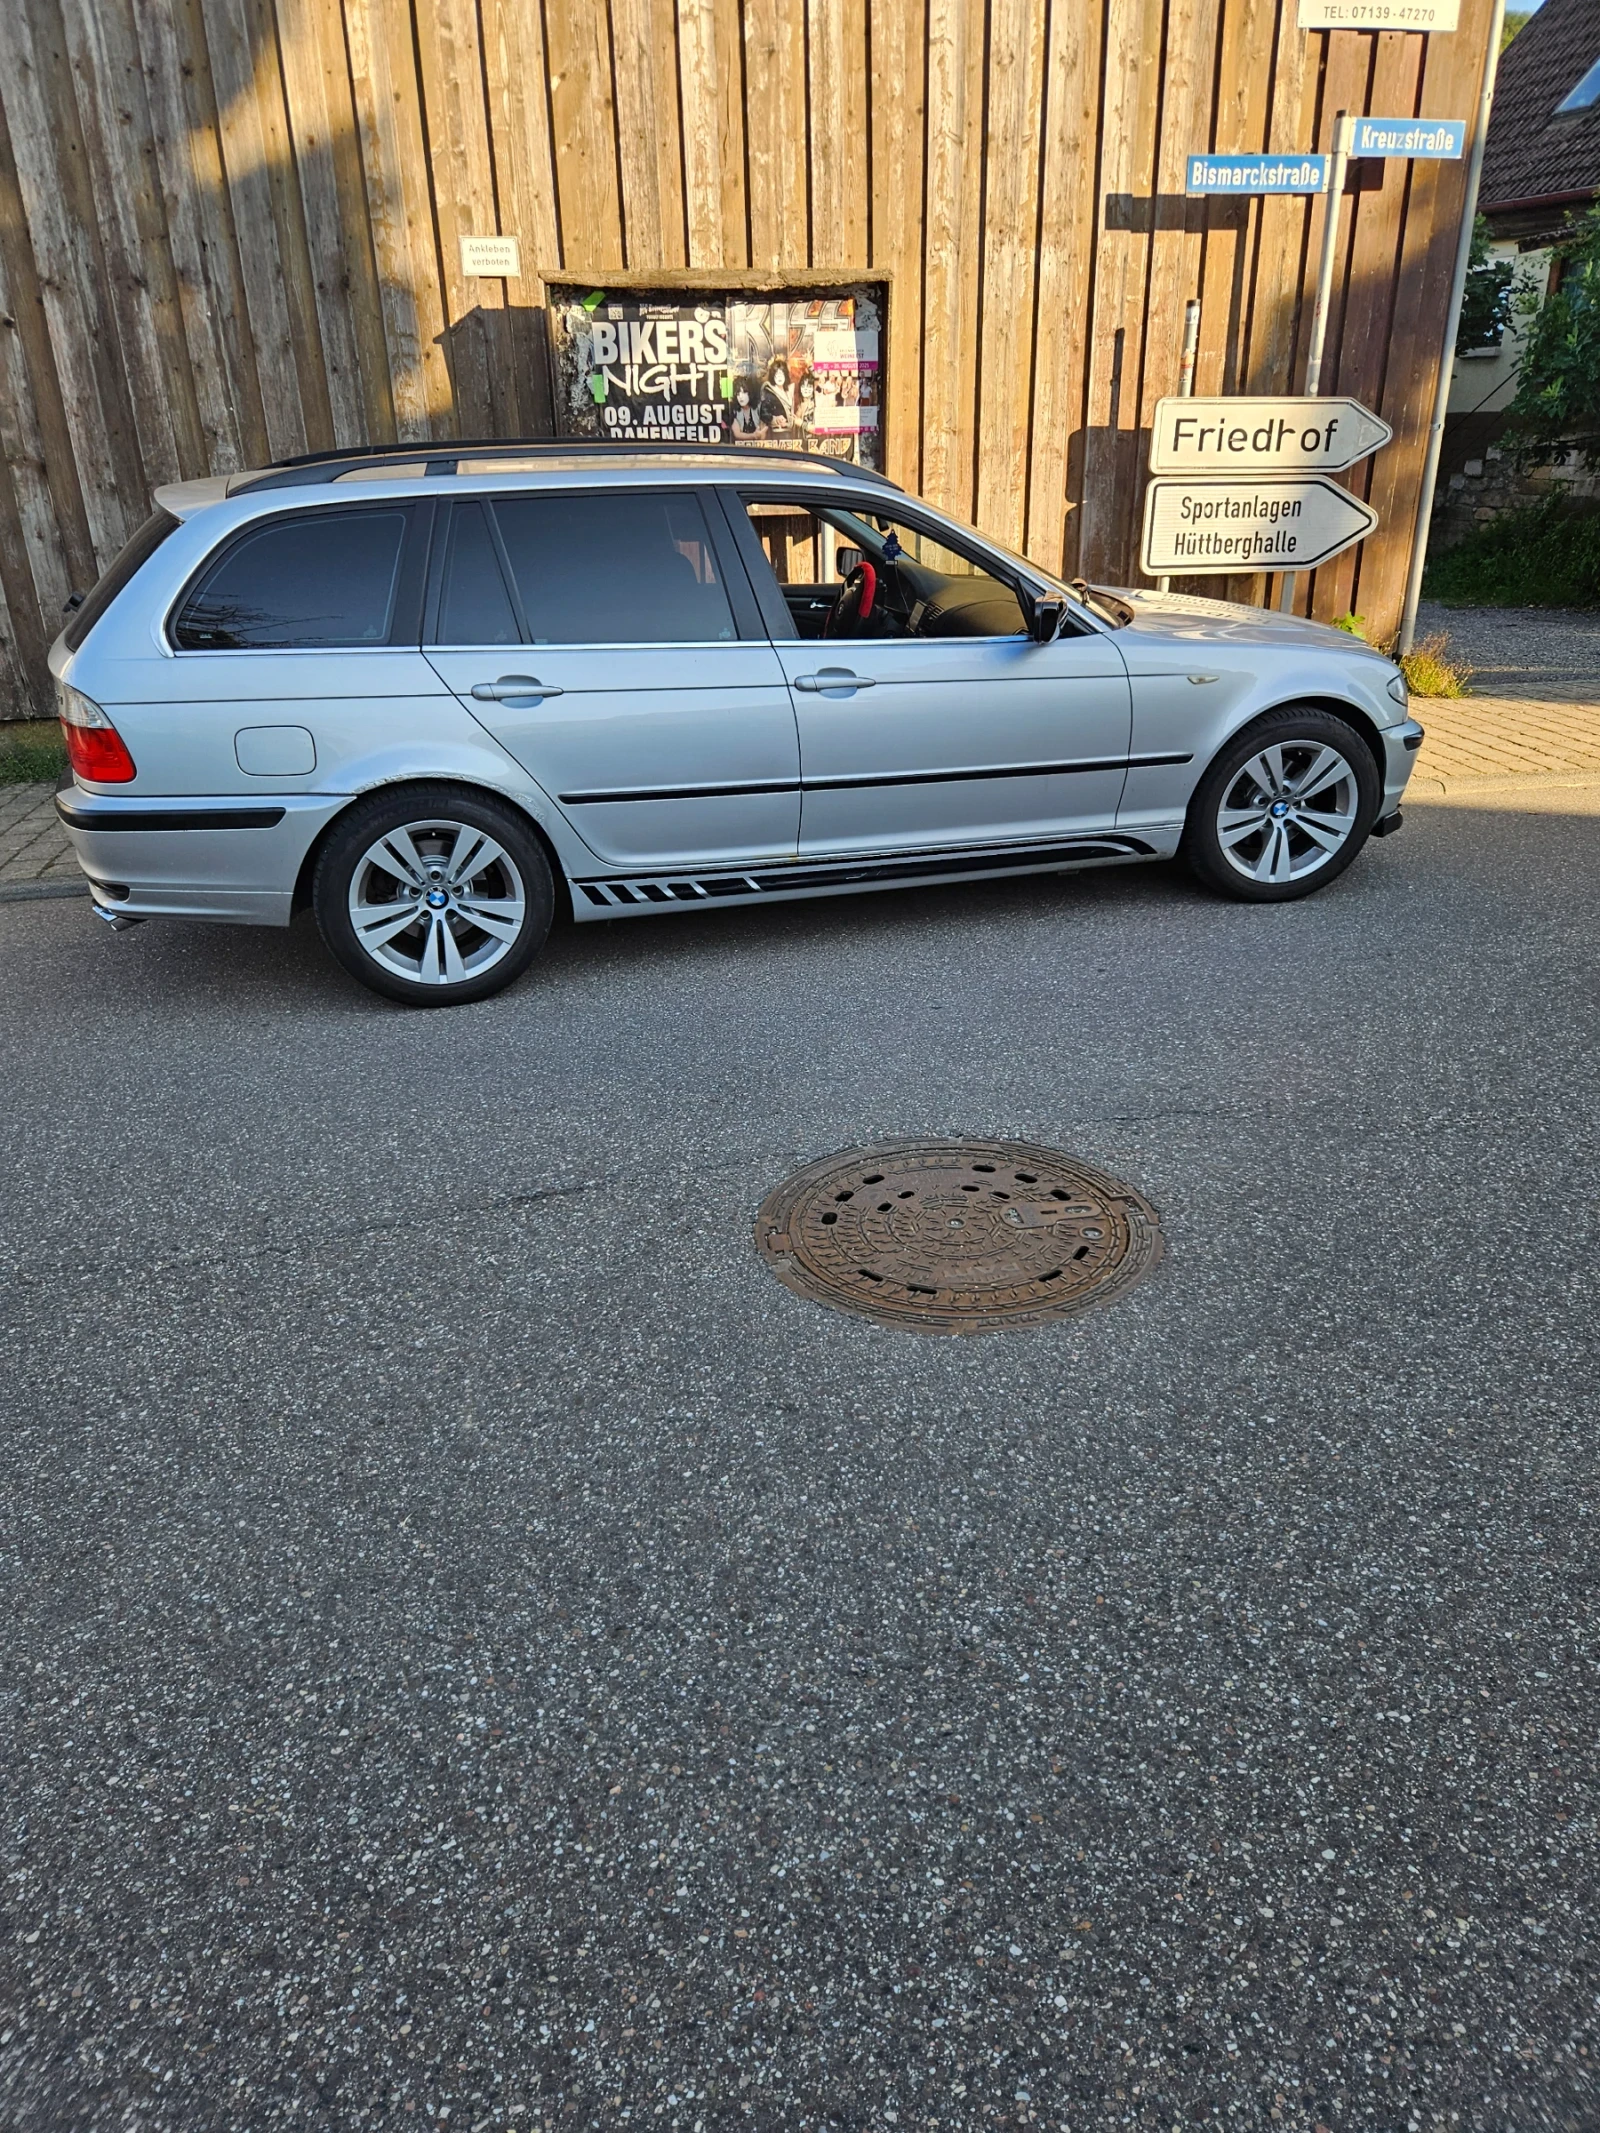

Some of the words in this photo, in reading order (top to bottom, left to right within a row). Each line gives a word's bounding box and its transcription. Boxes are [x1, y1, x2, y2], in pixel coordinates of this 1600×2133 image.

[1324, 6, 1348, 19] TEL:
[1361, 125, 1454, 151] Kreuzstraße
[1192, 162, 1320, 187] Bismarckstraße
[469, 244, 511, 253] Ankleben
[472, 258, 510, 266] verboten
[591, 320, 728, 364] BIKERS
[602, 363, 728, 402] NIGHT
[604, 406, 638, 426] 09.
[643, 404, 725, 425] AUGUST
[610, 425, 721, 443] DAHENFELD
[807, 438, 851, 455] BAND
[1180, 495, 1302, 525] Sportanlagen
[1174, 531, 1297, 560] Hüttberghalle
